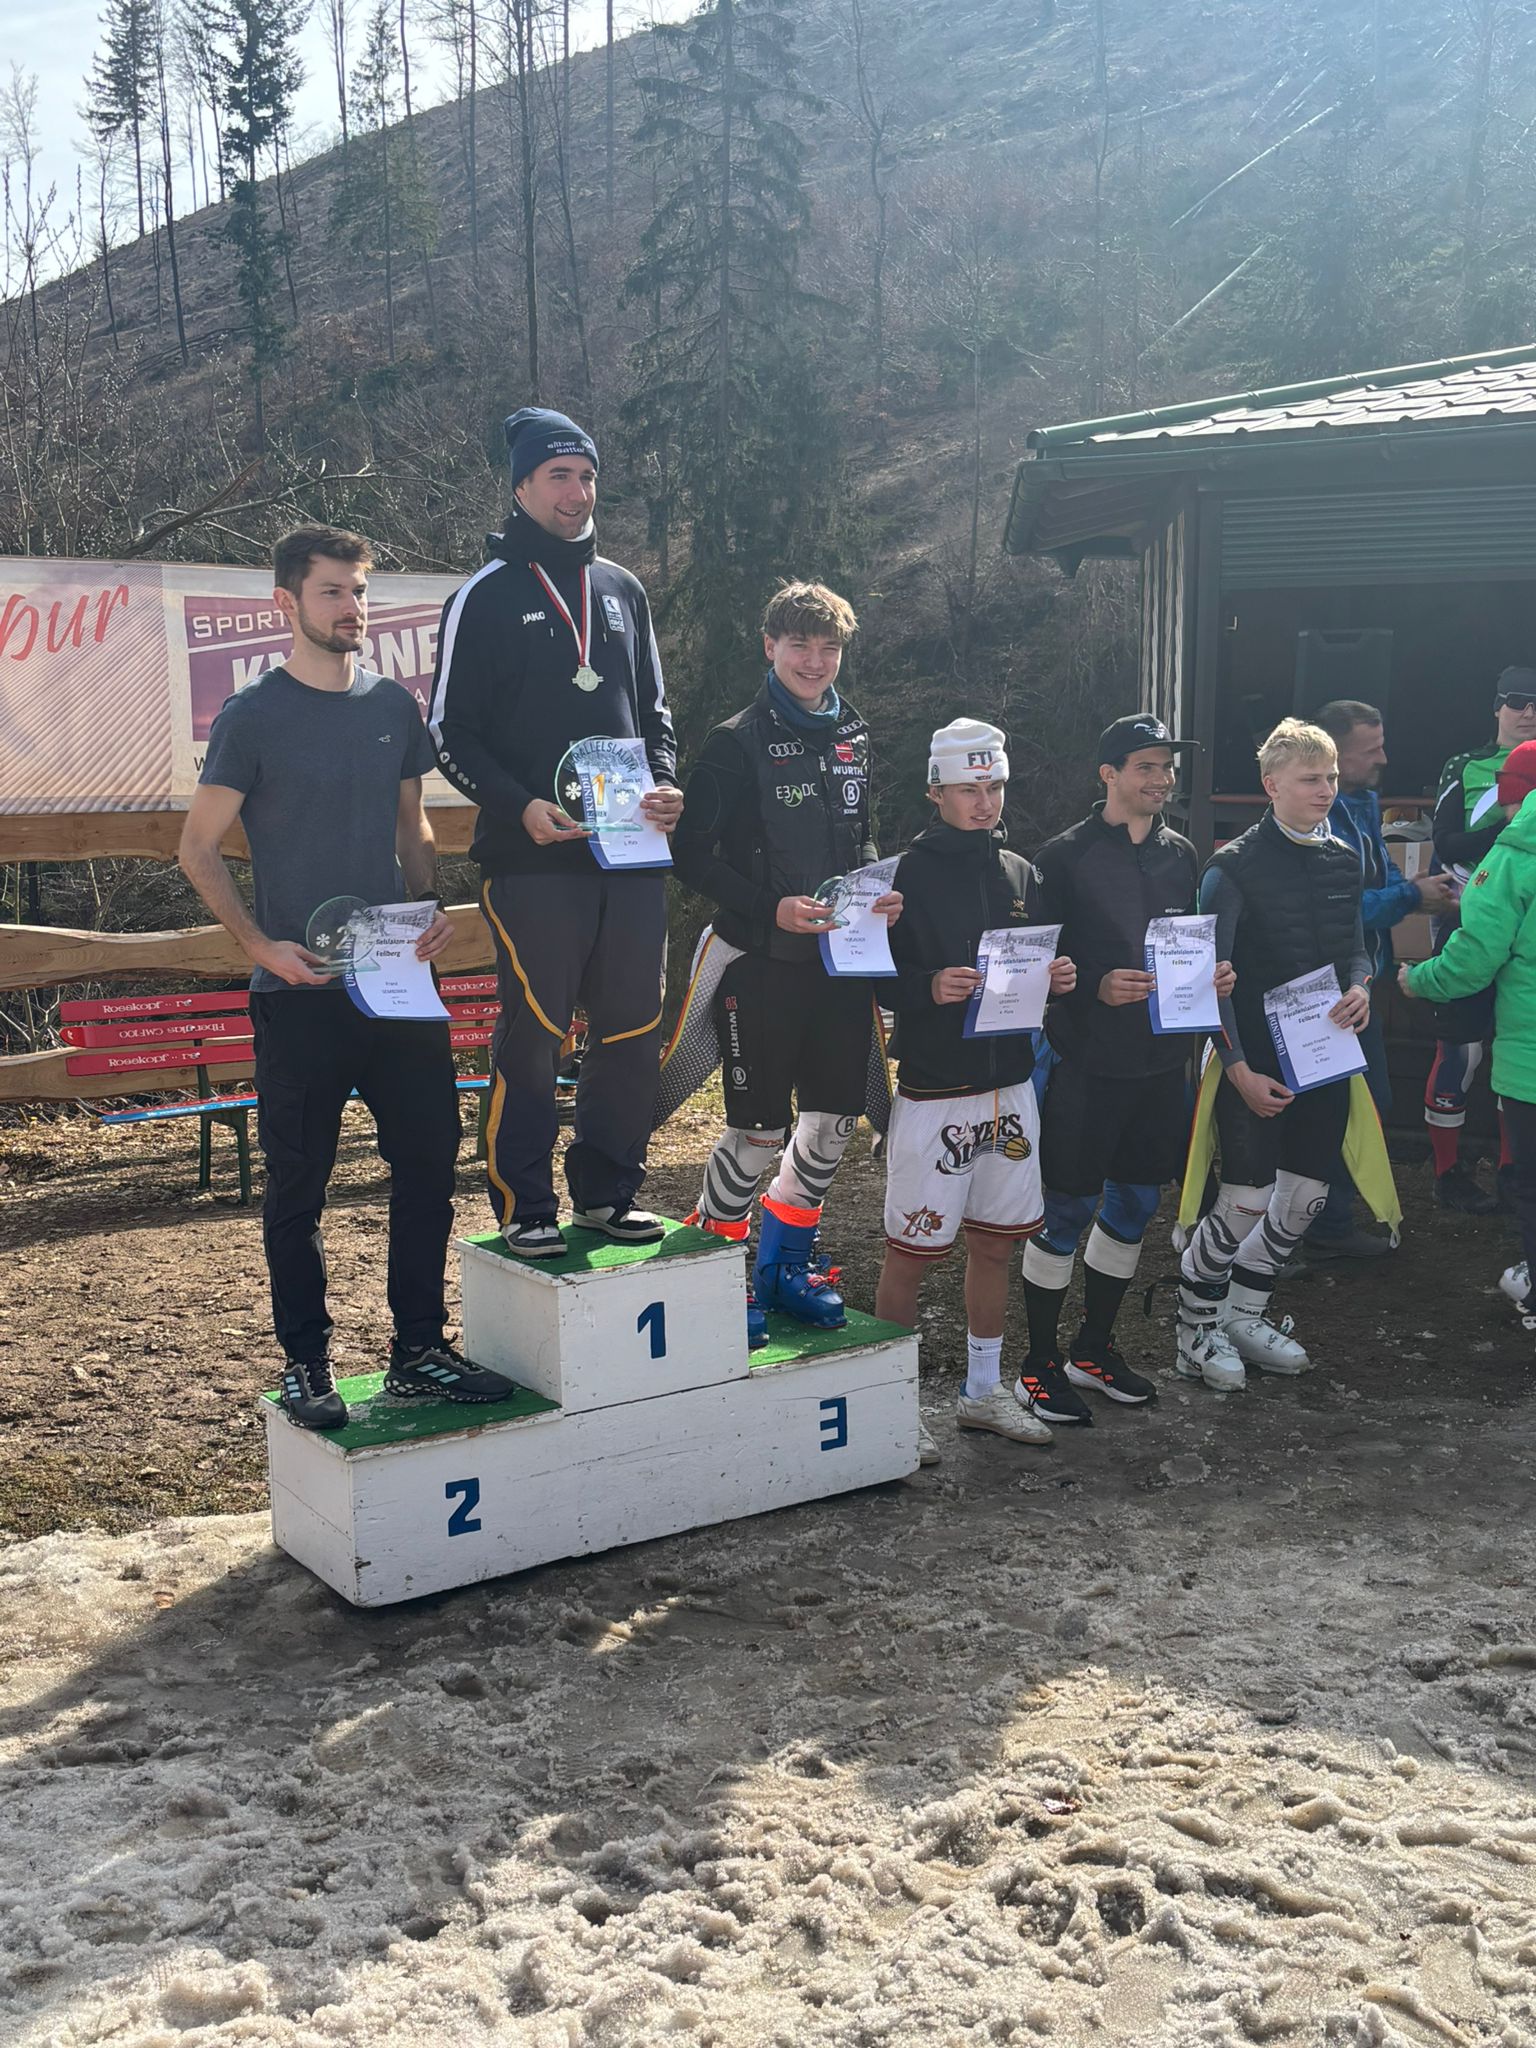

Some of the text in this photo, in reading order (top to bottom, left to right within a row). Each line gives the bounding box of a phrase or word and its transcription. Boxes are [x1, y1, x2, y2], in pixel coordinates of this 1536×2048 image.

[522, 611, 546, 625] JAKO
[968, 750, 993, 767] FTI
[592, 772, 606, 806] 1
[1268, 1015, 1287, 1056] URKUNDE
[1231, 1305, 1261, 1317] HEAD
[637, 1301, 666, 1360] 1
[819, 1396, 848, 1451] 3
[445, 1477, 482, 1537] 2
